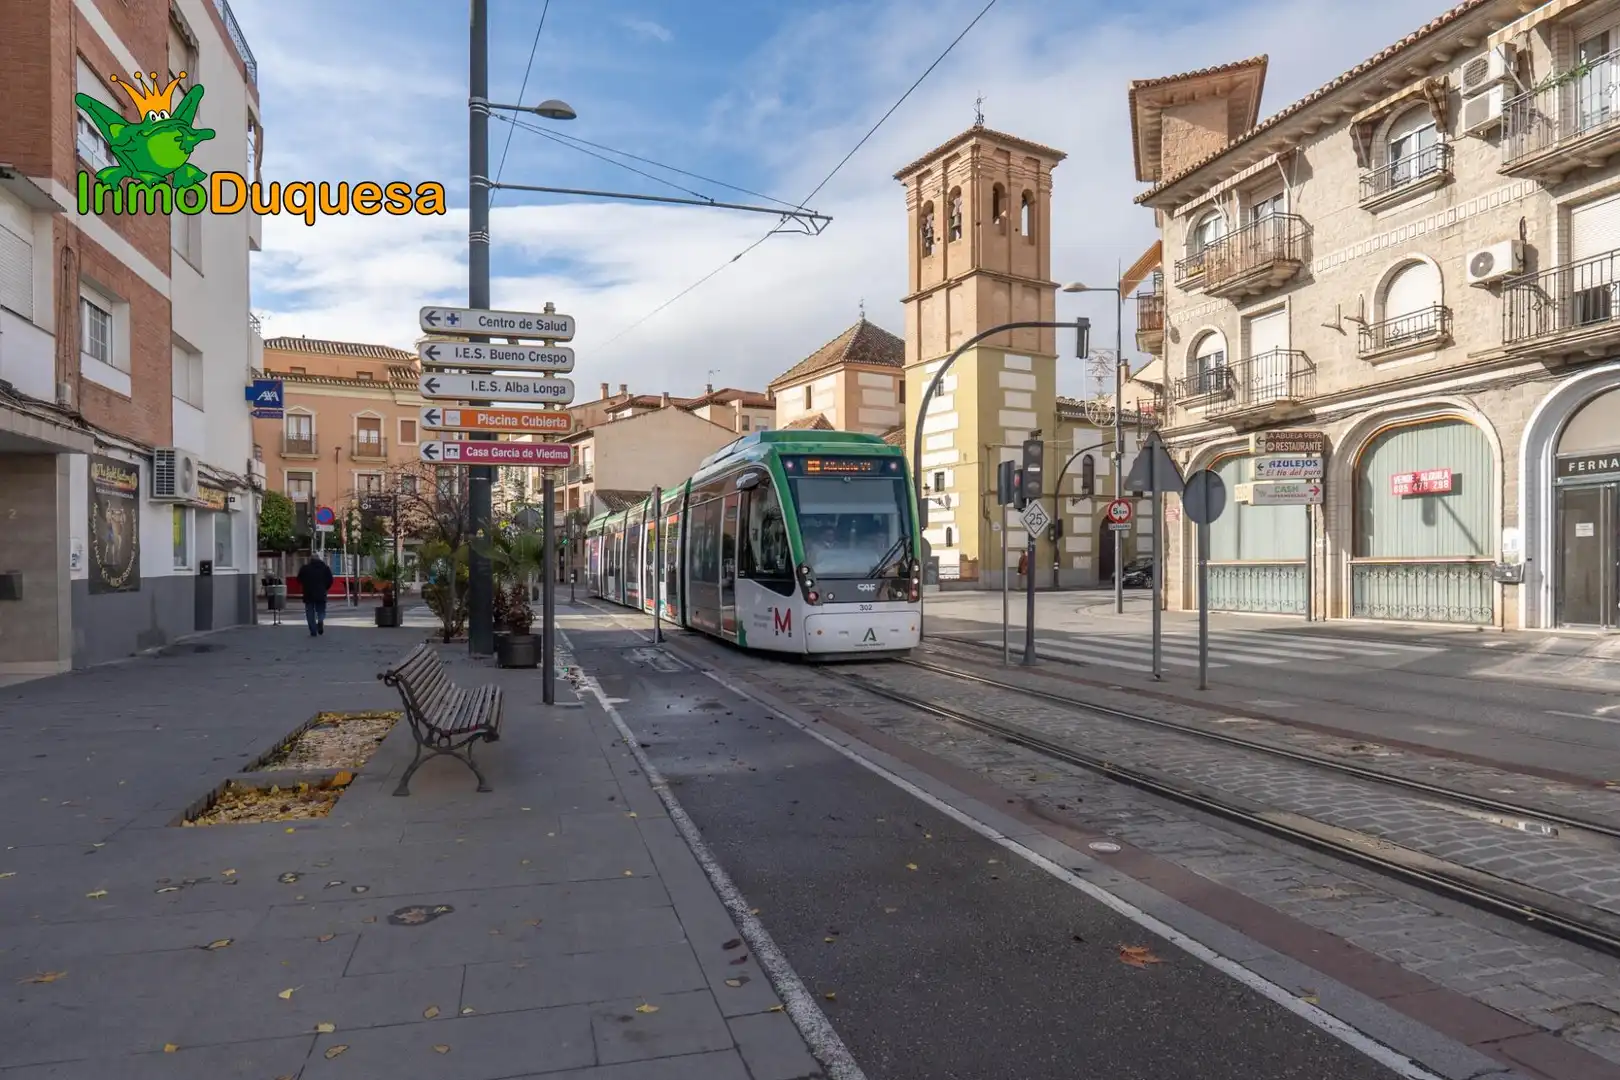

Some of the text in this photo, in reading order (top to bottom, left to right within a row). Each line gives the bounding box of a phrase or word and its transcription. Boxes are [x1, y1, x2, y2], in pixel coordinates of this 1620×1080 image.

[478, 315, 568, 332] Centro de Salud
[455, 347, 567, 366] I.E.S. Bueno Crespo
[471, 380, 566, 396] I.E.S. Alba Longa
[256, 390, 280, 402] AXA
[477, 413, 568, 428] Piscina Cubierta
[1275, 441, 1322, 451] RESTAURANTE
[466, 446, 568, 460] Casa García de Viedma
[1268, 460, 1318, 468] AZULEJOS
[1568, 458, 1620, 472] FERNA
[1289, 468, 1302, 476] del
[8, 508, 17, 520] 2
[1029, 513, 1042, 526] 25
[857, 584, 876, 592] CAF
